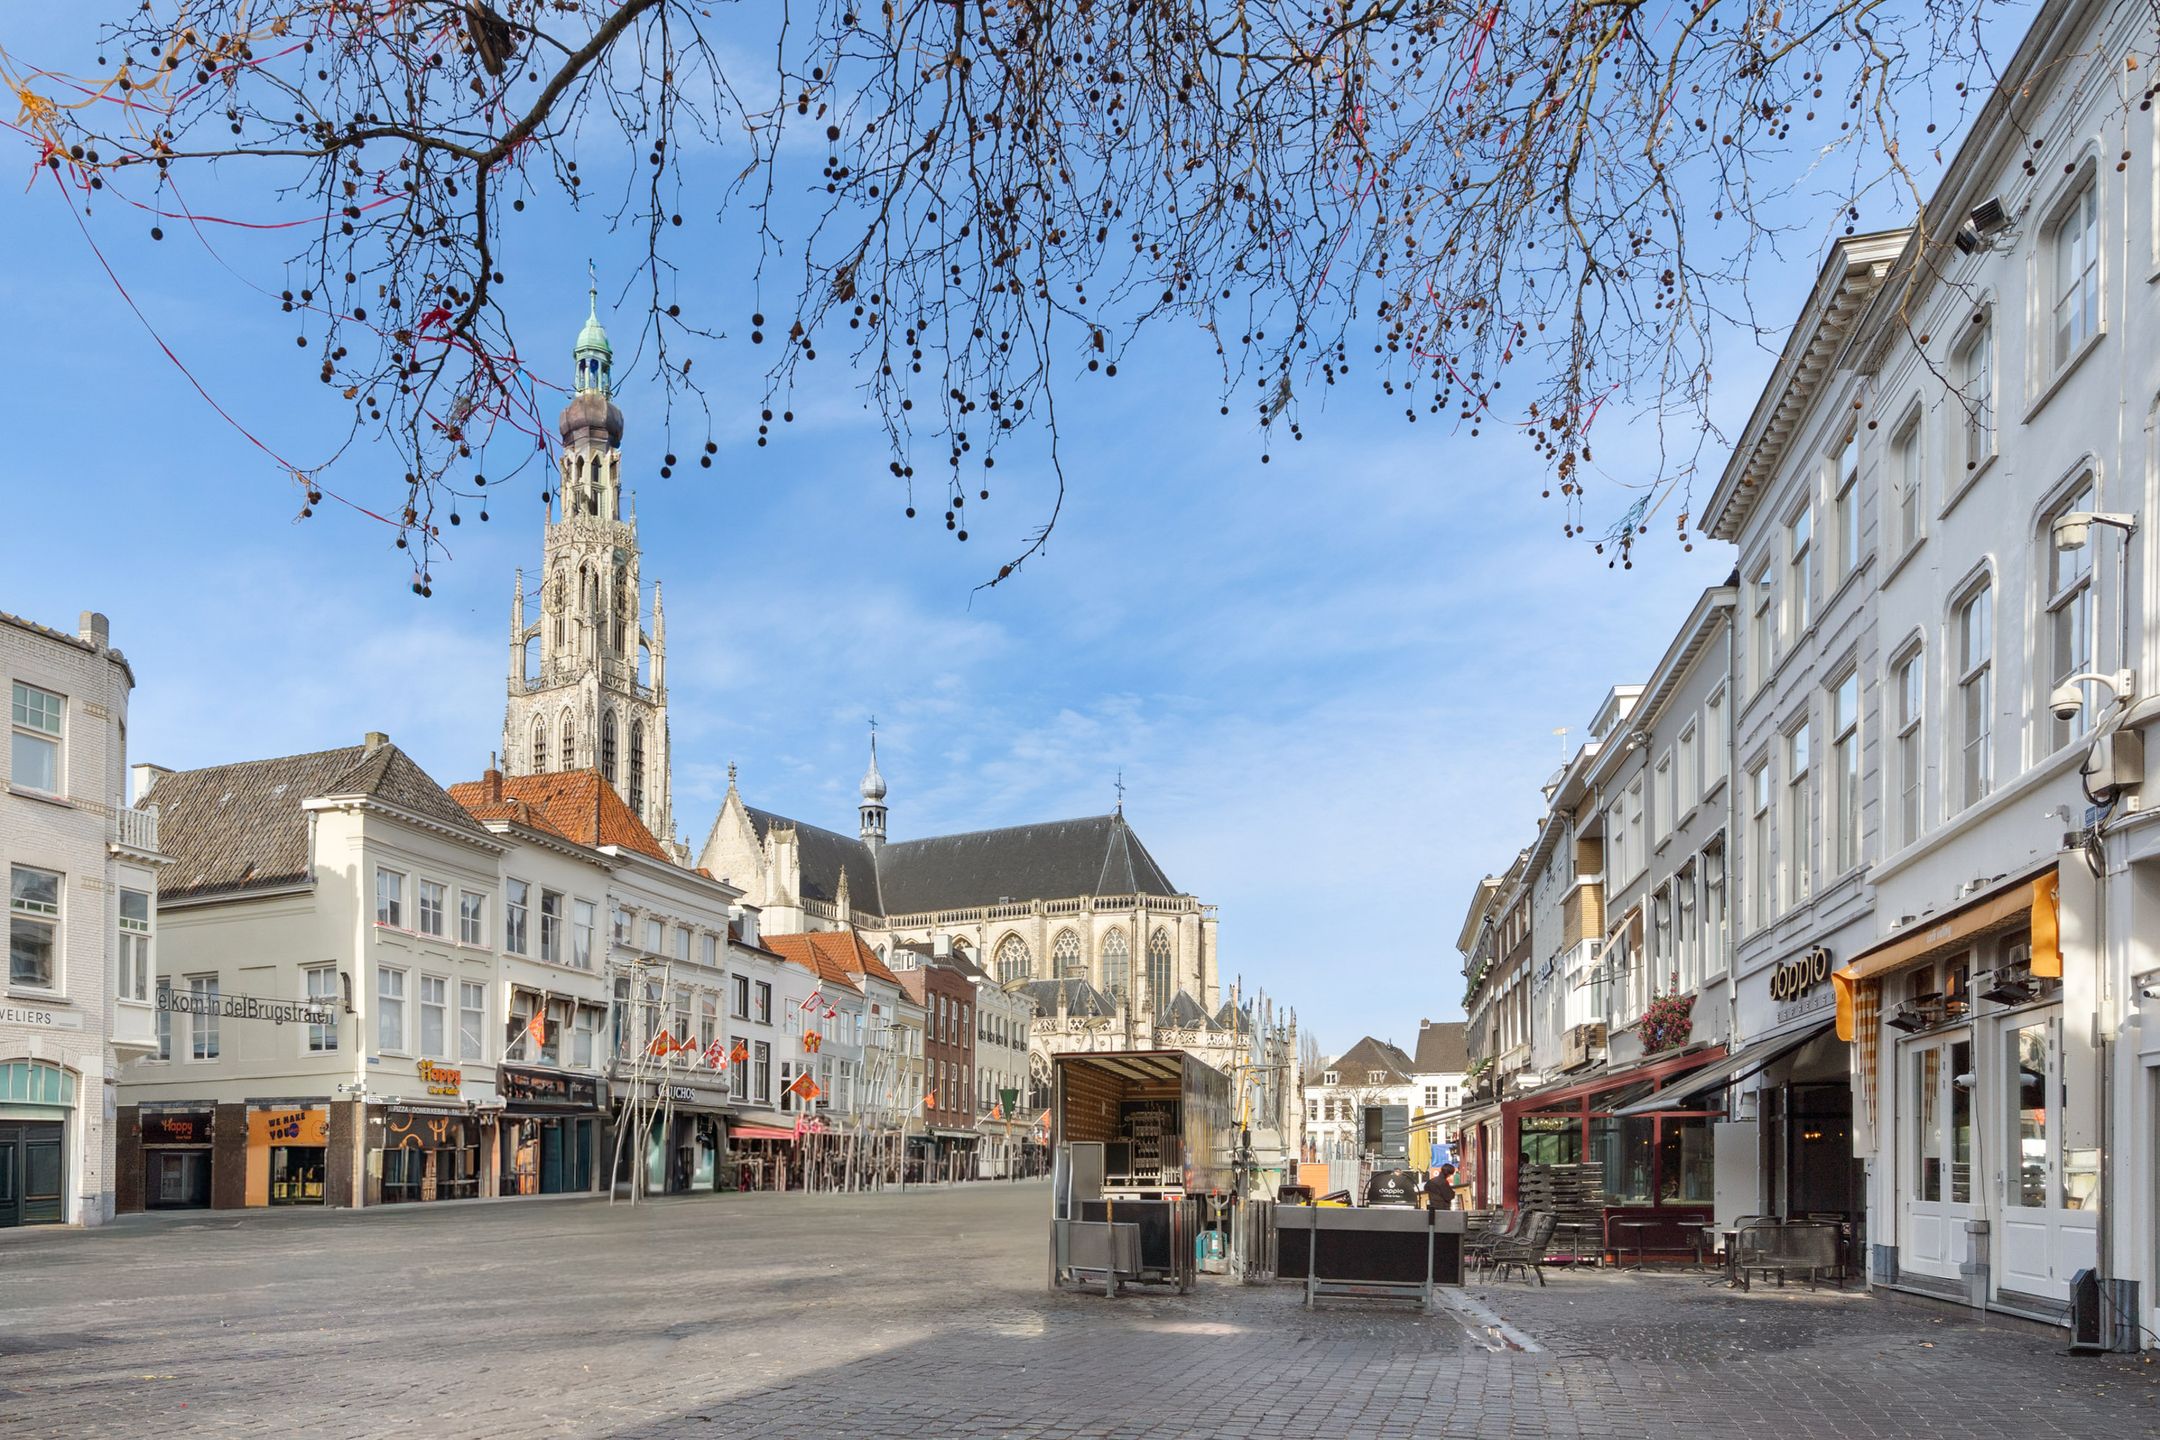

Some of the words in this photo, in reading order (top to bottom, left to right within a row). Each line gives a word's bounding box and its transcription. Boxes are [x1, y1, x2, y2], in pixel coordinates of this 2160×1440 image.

[1770, 945, 1830, 1001] doppio
[416, 1059, 461, 1086] Happy
[161, 1118, 193, 1135] Happy
[268, 1118, 281, 1127] WE
[283, 1112, 306, 1124] MAKE
[269, 1126, 290, 1140] YOU
